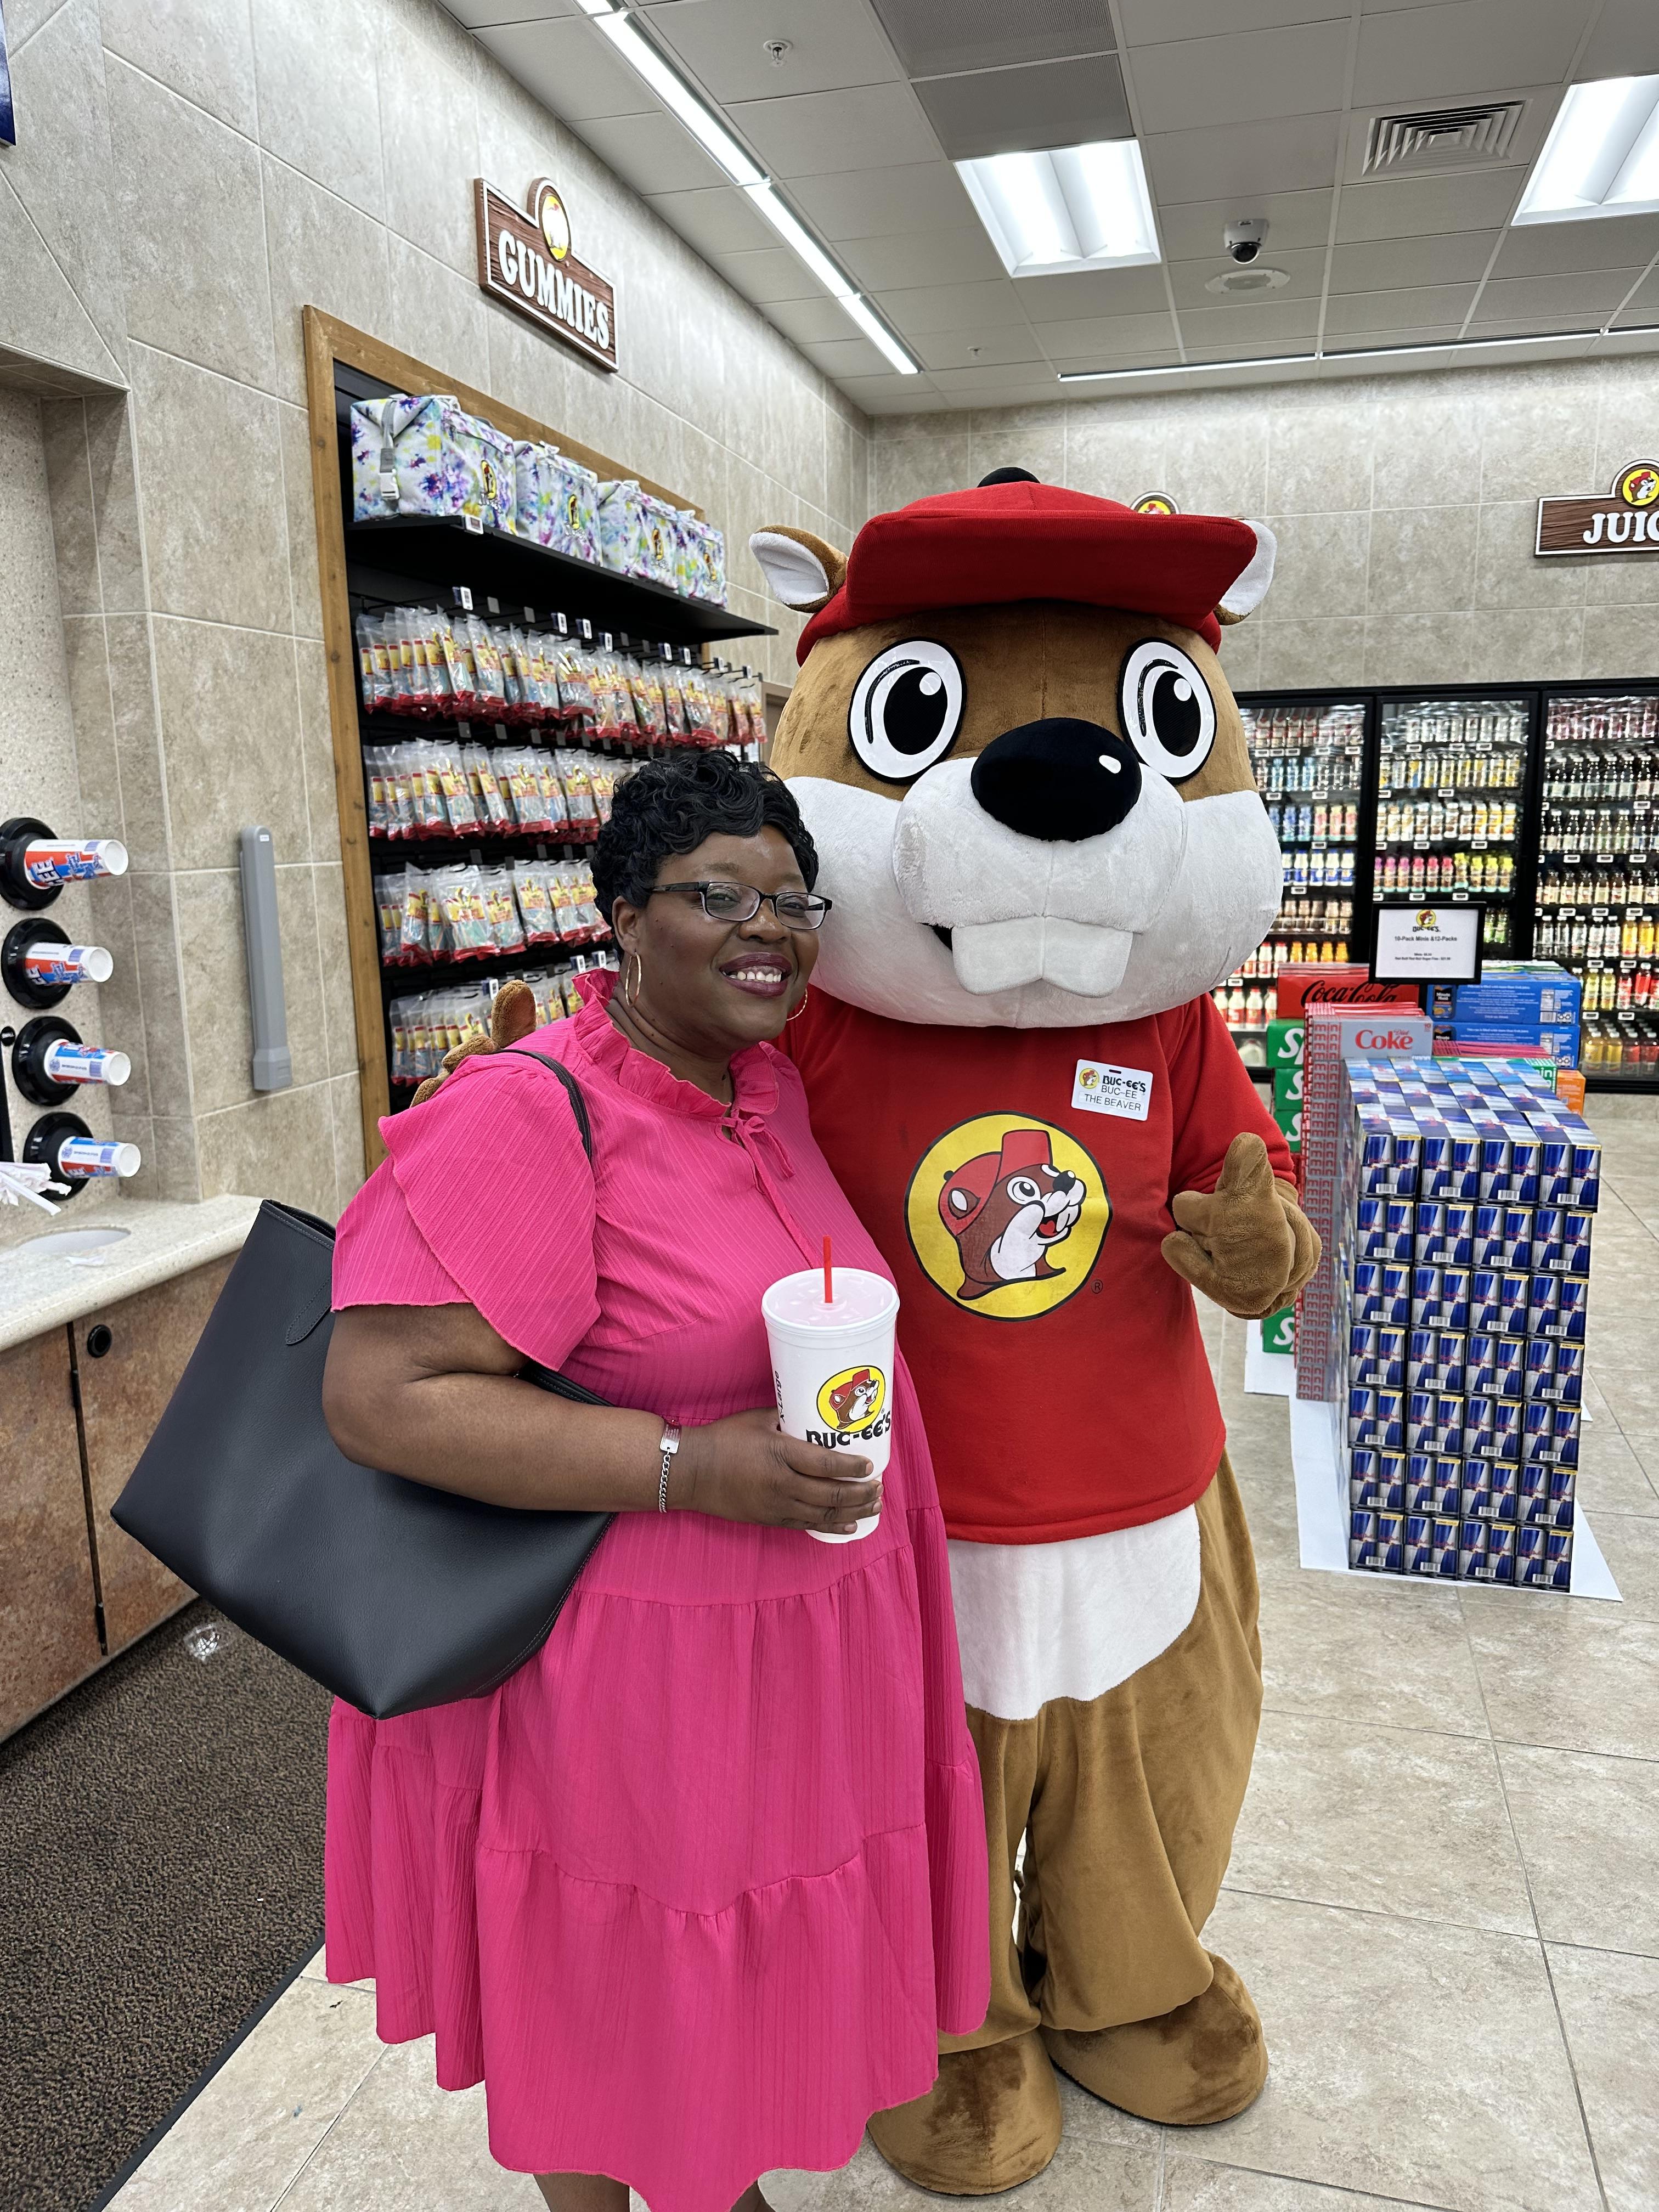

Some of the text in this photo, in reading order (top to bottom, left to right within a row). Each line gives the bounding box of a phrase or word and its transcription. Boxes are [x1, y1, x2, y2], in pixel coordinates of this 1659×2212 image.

[499, 230, 610, 350] GUMMIES
[1355, 1030, 1414, 1050] Coke
[1084, 1093, 1141, 1111] THE BEAVER
[1101, 1085, 1138, 1099] BUC-EE
[774, 1370, 786, 1424] X-Large
